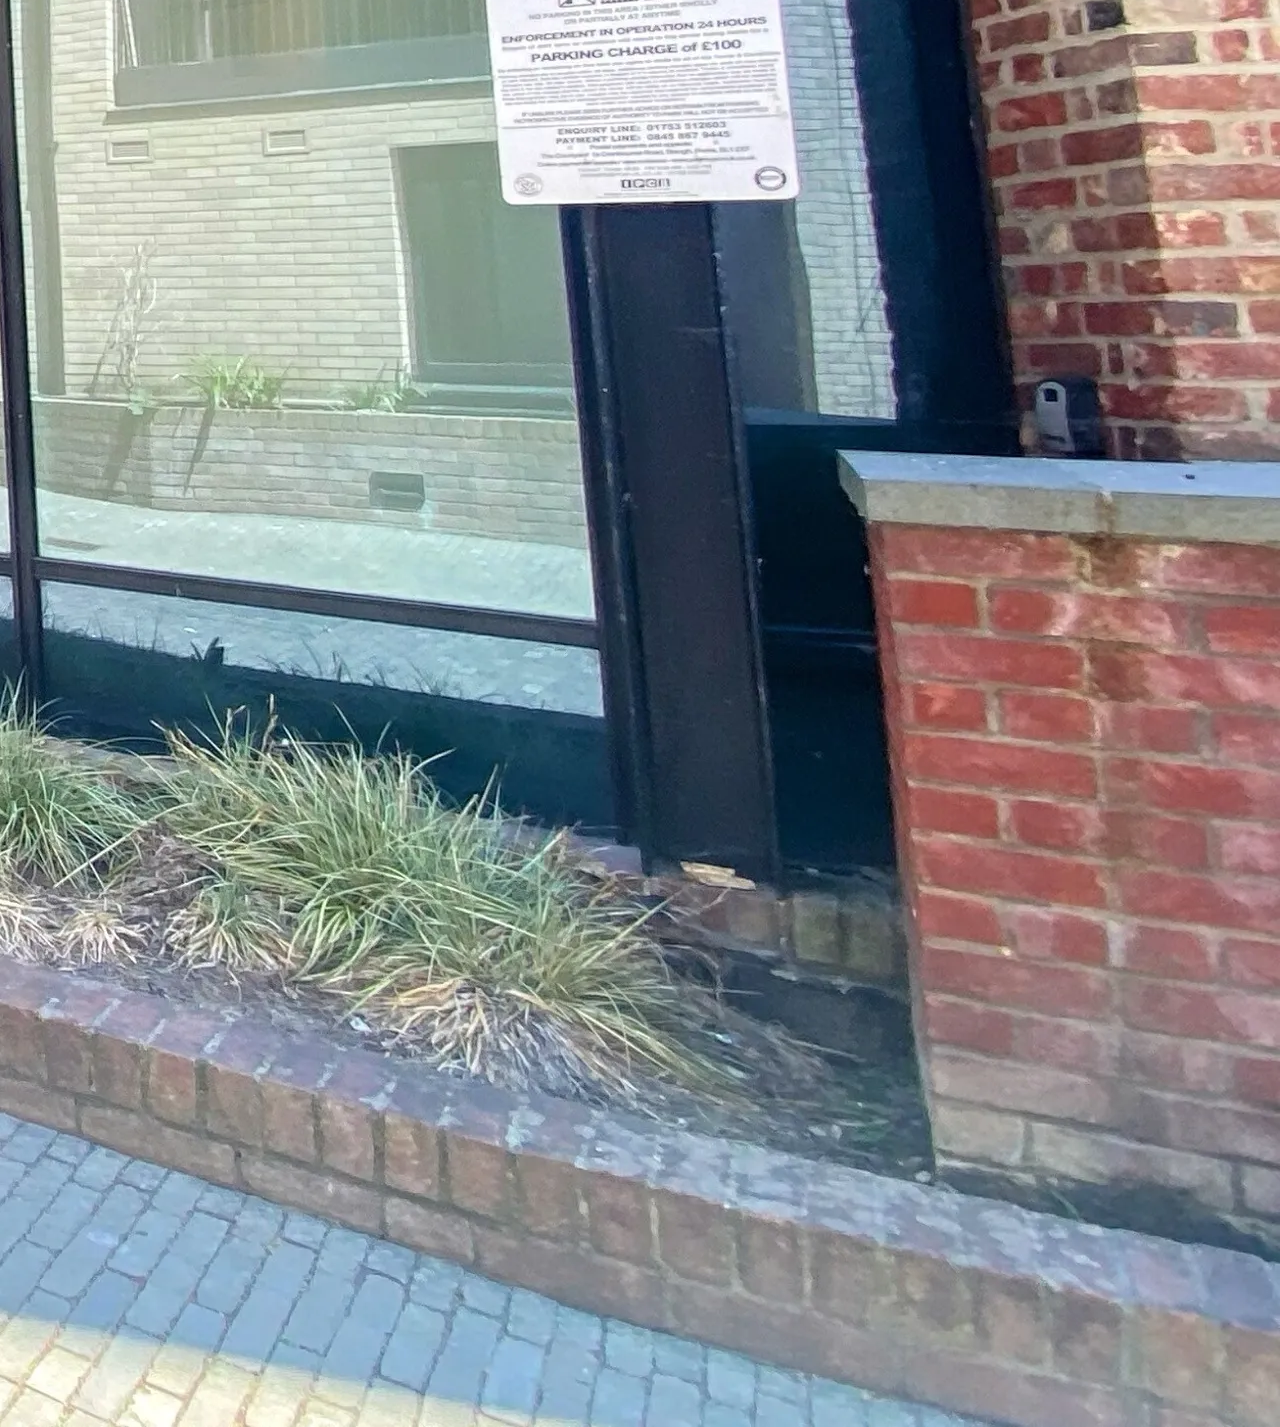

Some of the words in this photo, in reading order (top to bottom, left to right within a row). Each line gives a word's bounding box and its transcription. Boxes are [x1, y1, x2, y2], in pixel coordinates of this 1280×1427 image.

[502, 29, 596, 44] ENFORCEMENT
[600, 27, 612, 36] IN
[616, 20, 694, 35] OPERATION
[697, 19, 714, 29] 24
[717, 15, 768, 28] HOURS
[531, 49, 604, 62] PARKING
[608, 43, 679, 58] CHARGE
[681, 41, 697, 52] of
[702, 38, 743, 51] £100
[556, 135, 608, 144] PAYMENT
